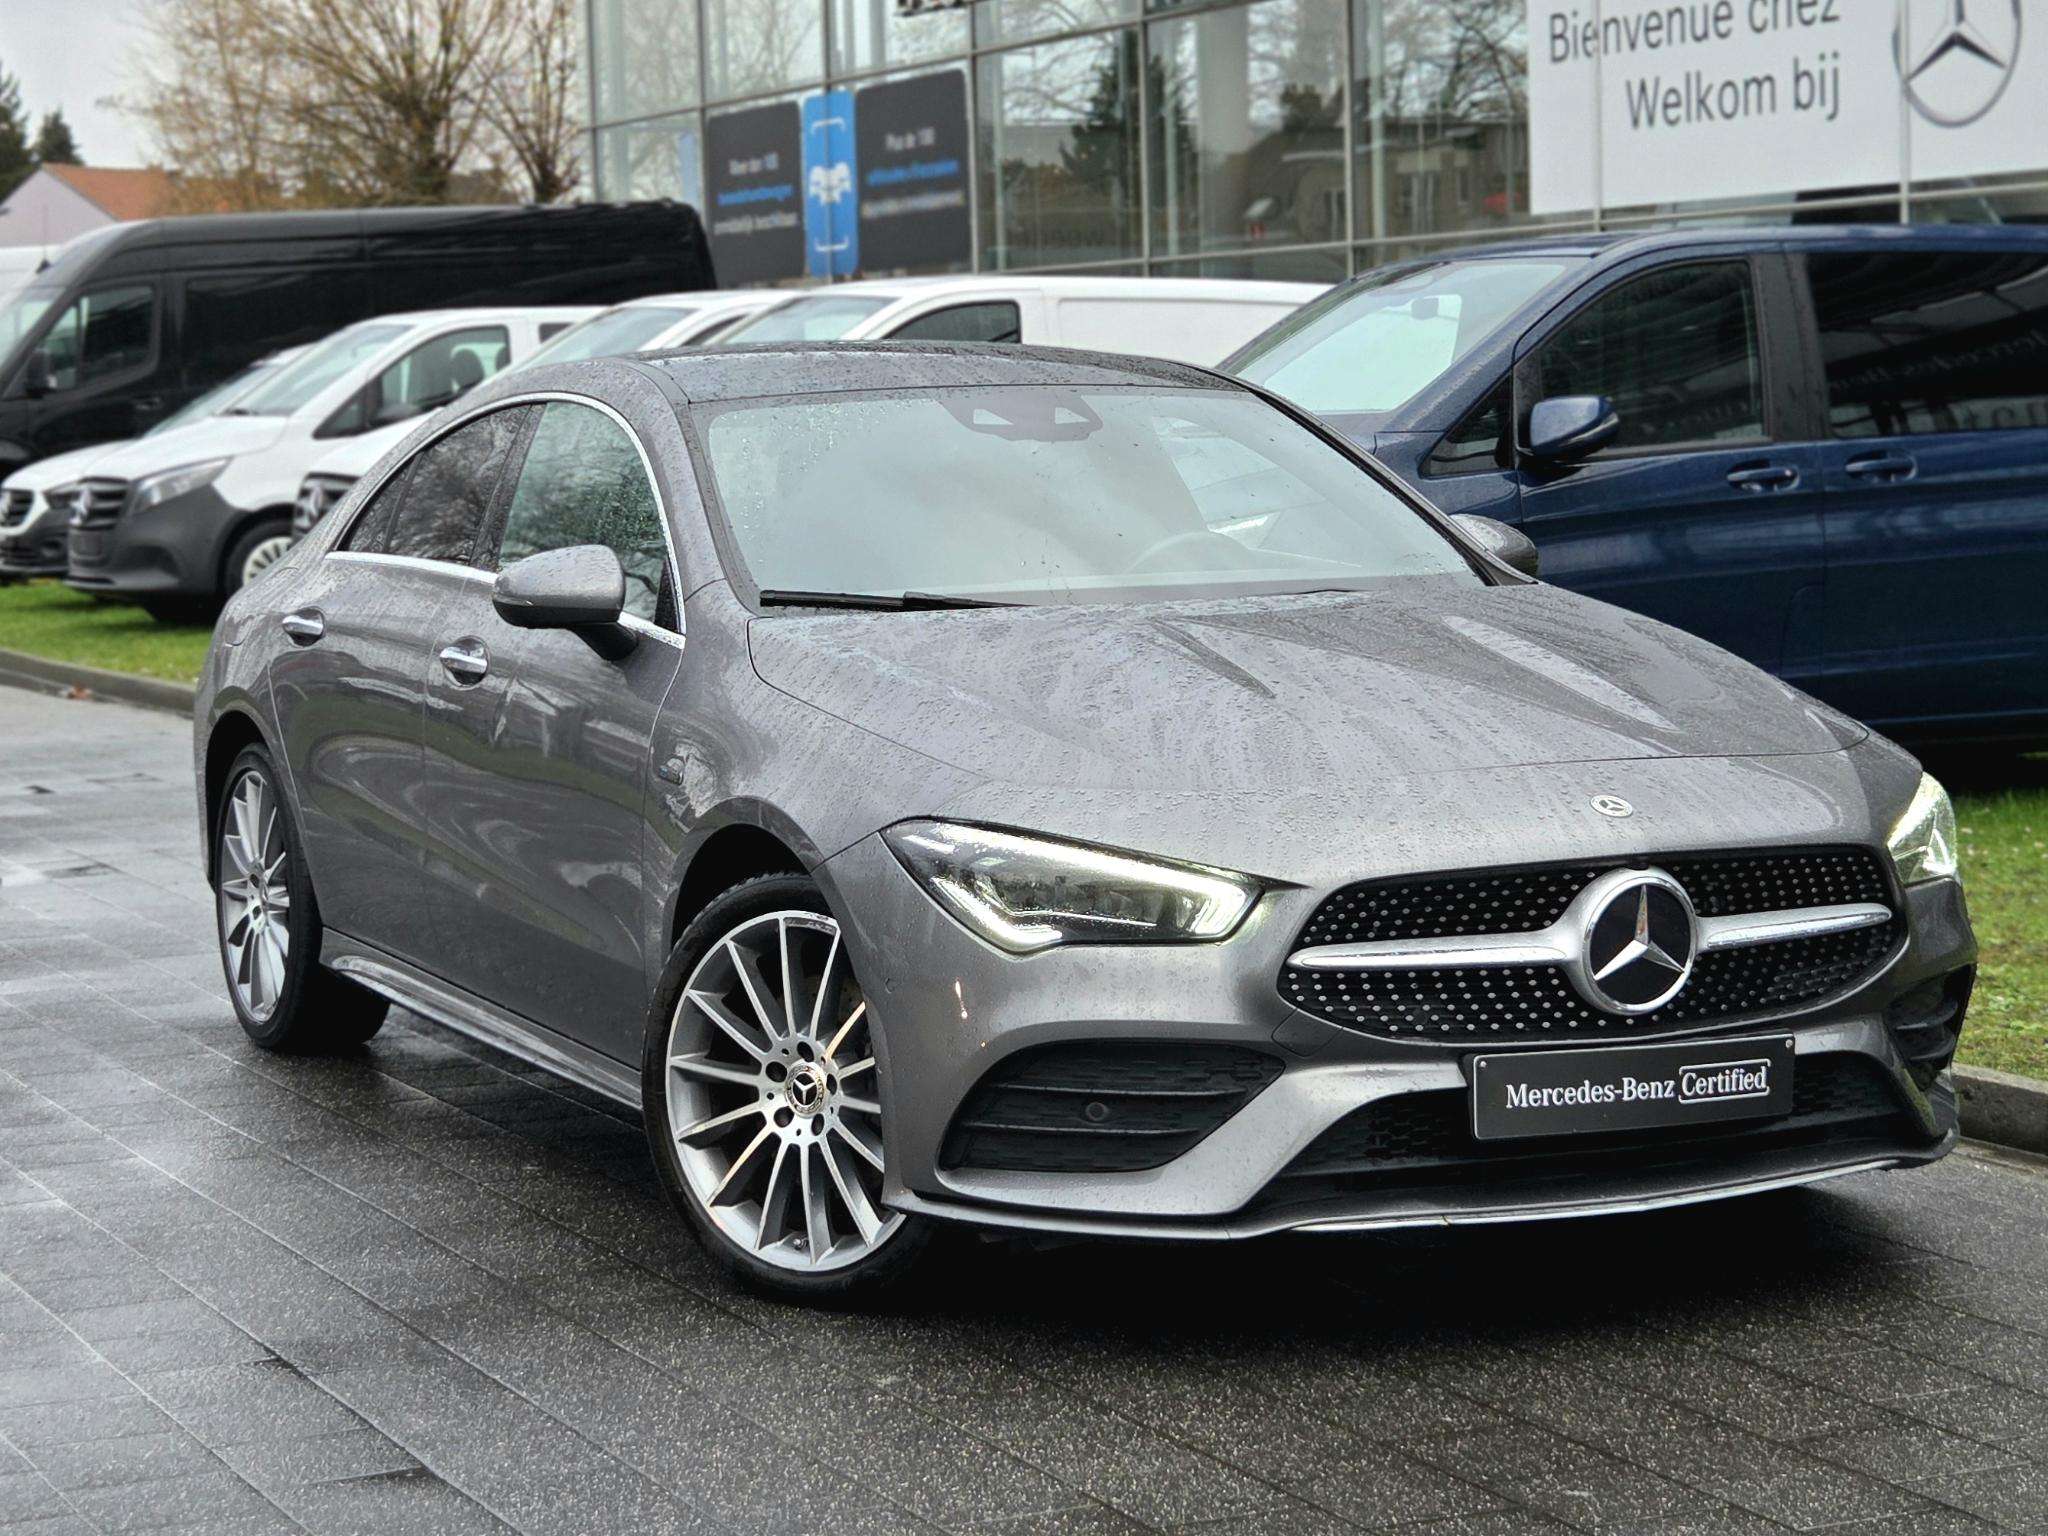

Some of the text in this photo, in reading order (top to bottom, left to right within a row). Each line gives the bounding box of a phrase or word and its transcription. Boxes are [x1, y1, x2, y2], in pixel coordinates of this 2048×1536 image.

[1549, 1, 1733, 63] Bienvenue
[1626, 51, 1841, 129] Welkom bij
[1505, 1066, 1768, 1109] Mercedes-Benz Certified
